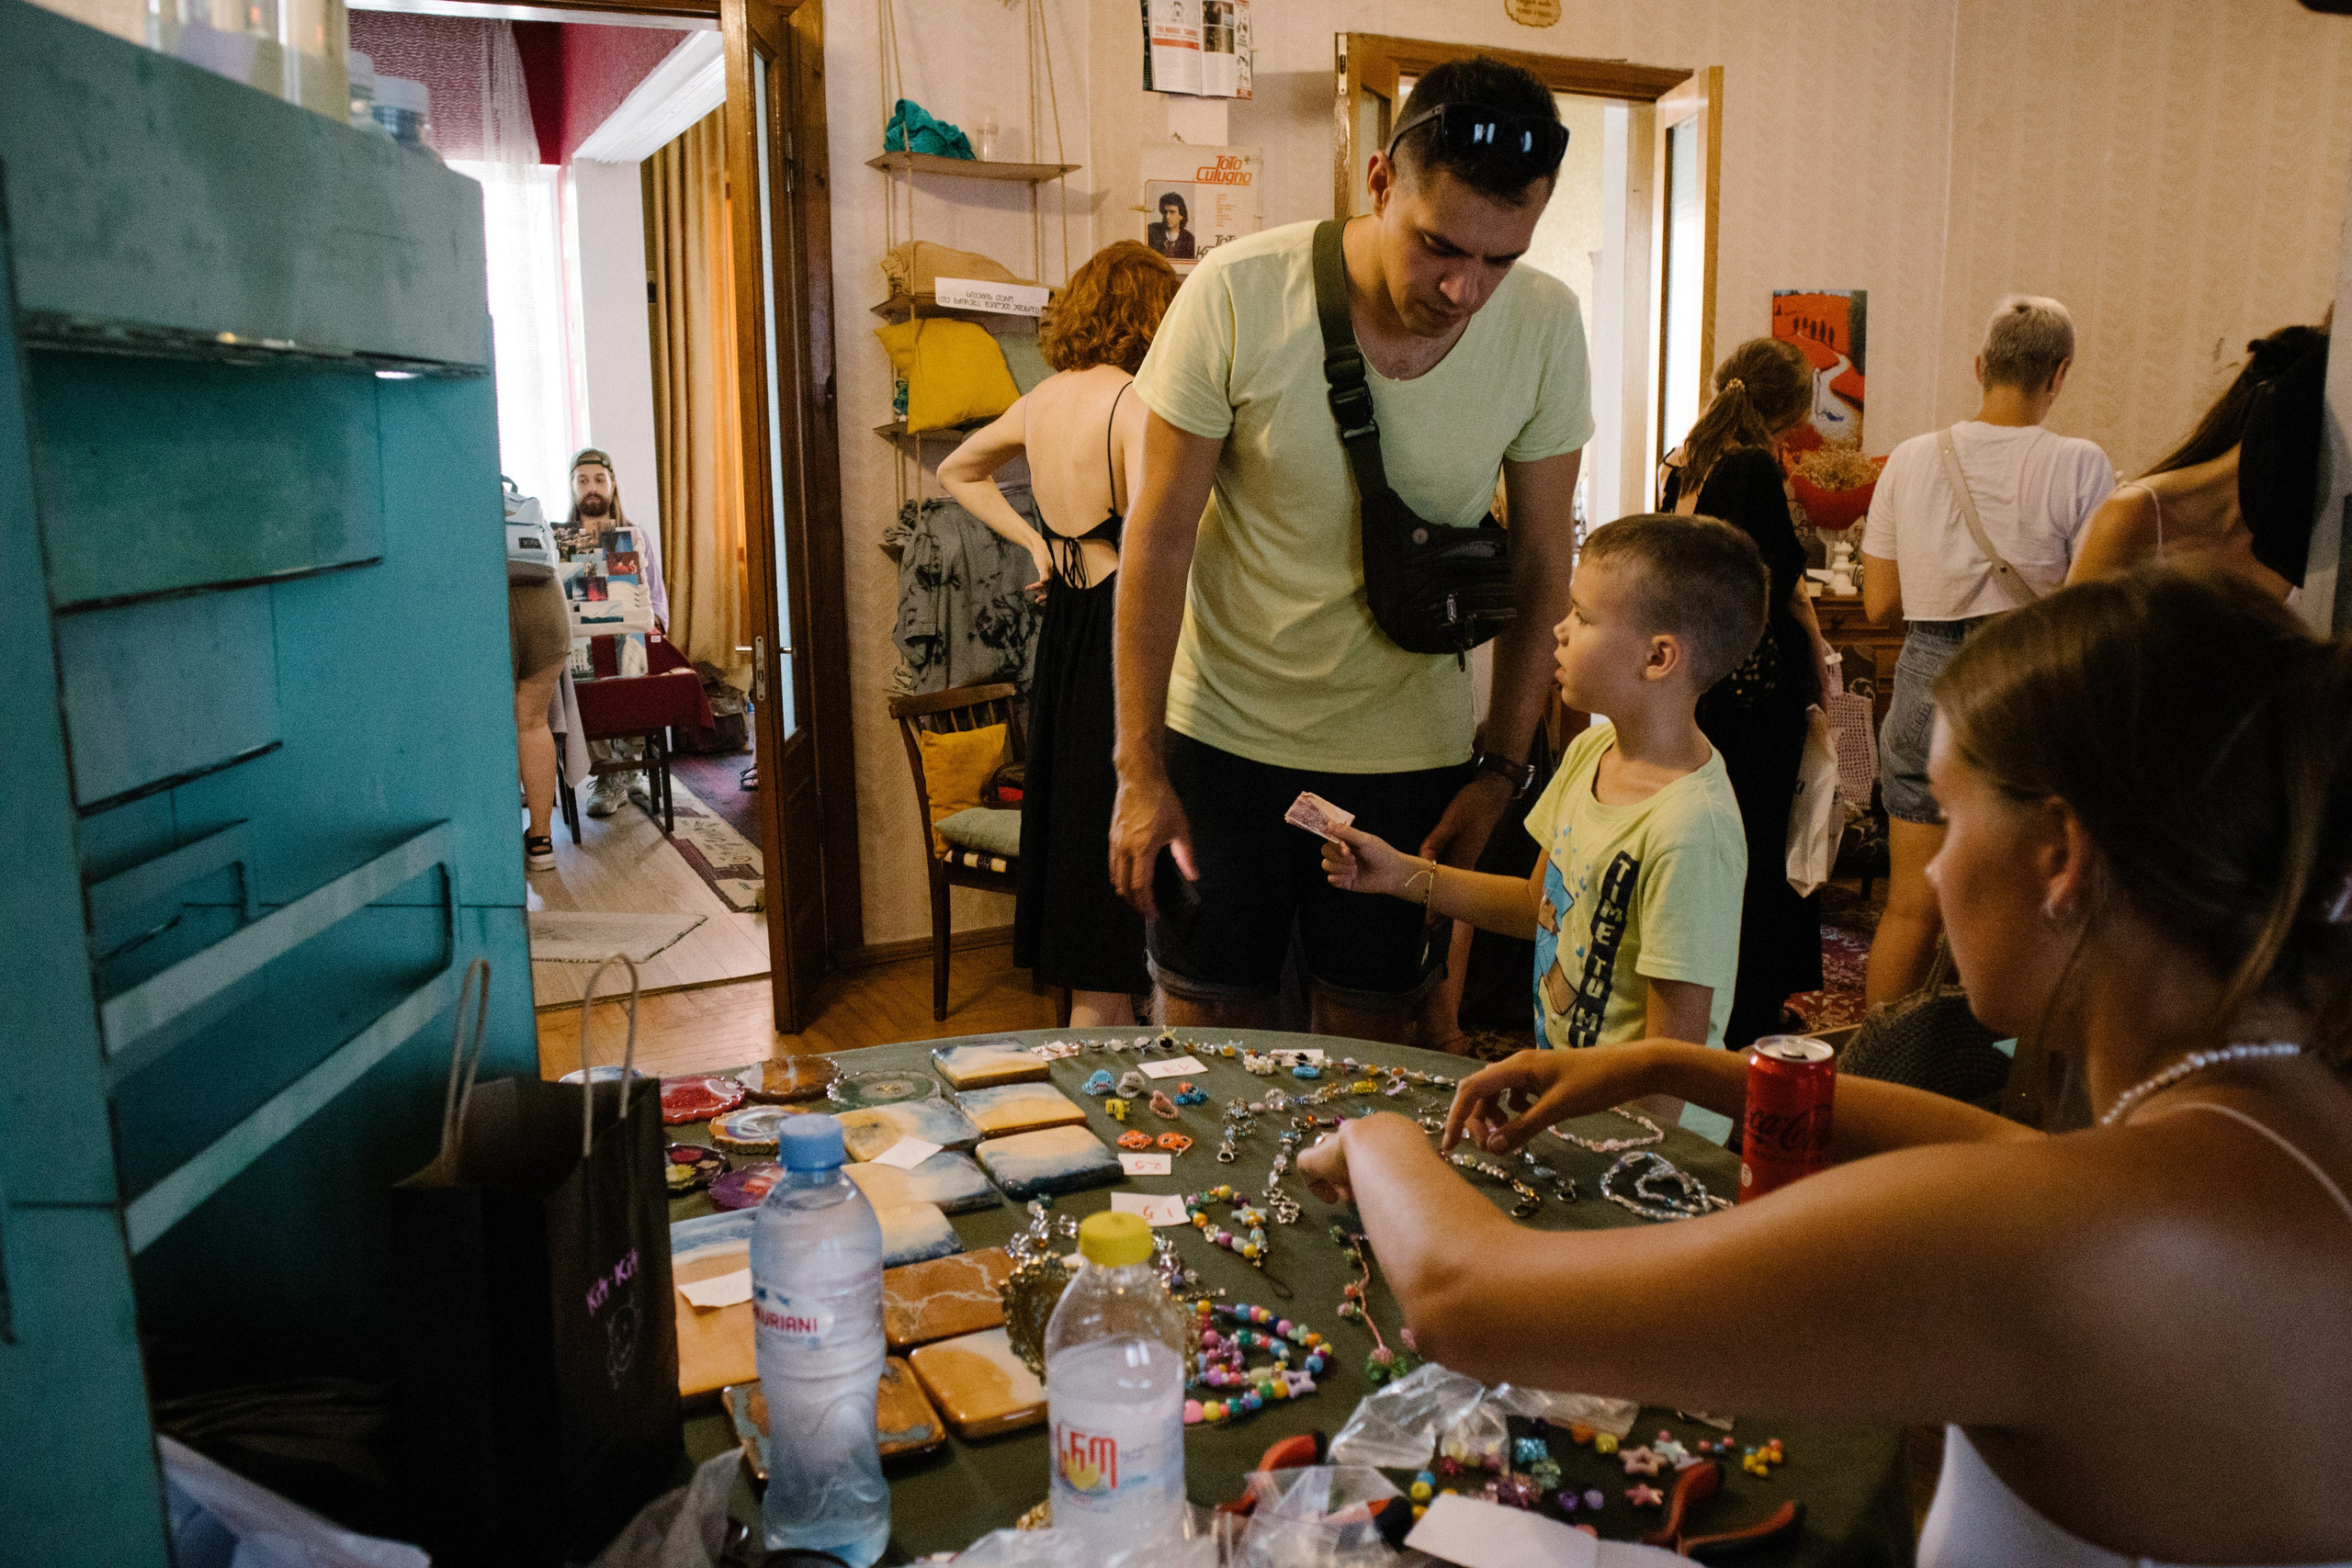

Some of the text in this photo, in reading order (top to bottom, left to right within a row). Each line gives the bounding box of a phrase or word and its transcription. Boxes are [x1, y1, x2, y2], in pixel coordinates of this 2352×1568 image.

[1196, 166, 1253, 186] Cutugno
[1595, 858, 1632, 946] TIME
[1128, 1159, 1163, 1173] 25
